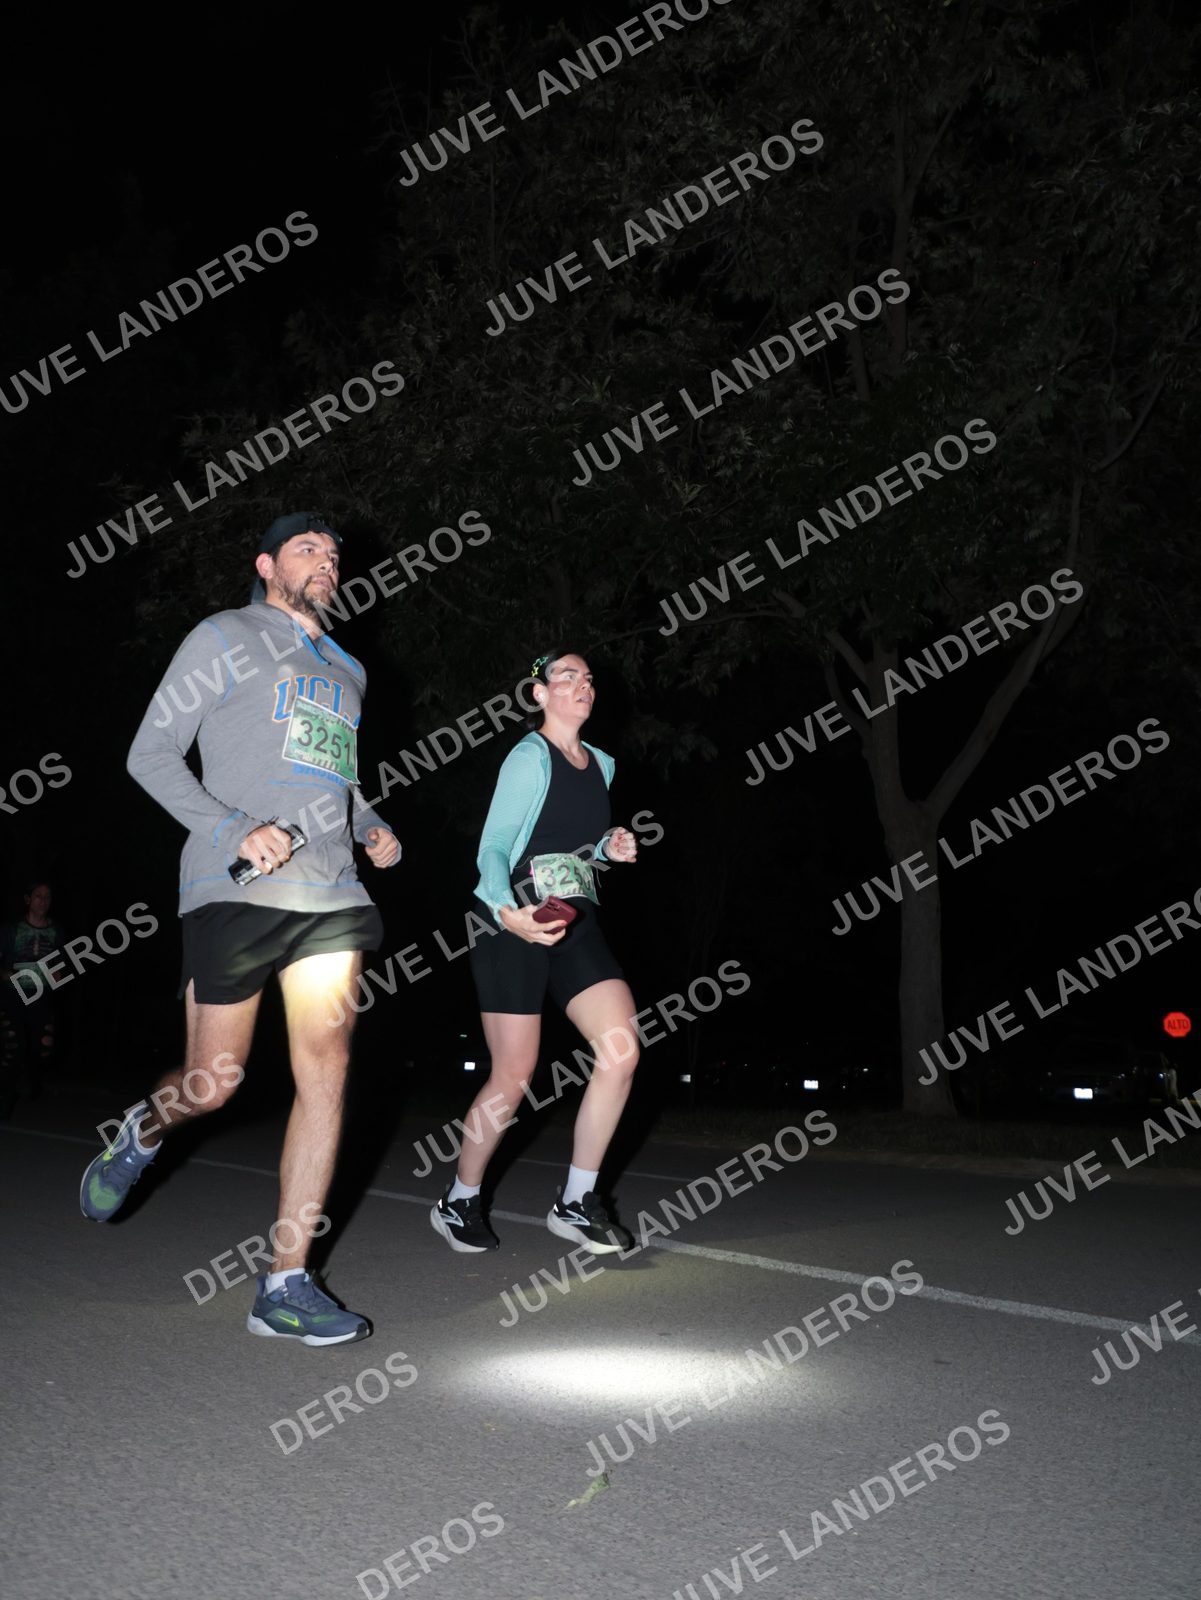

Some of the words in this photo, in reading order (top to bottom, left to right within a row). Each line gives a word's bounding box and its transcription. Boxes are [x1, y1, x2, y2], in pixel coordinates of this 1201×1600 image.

[272, 674, 361, 729] UCL
[297, 719, 351, 766] 3251
[1167, 1019, 1190, 1030] ALTO
